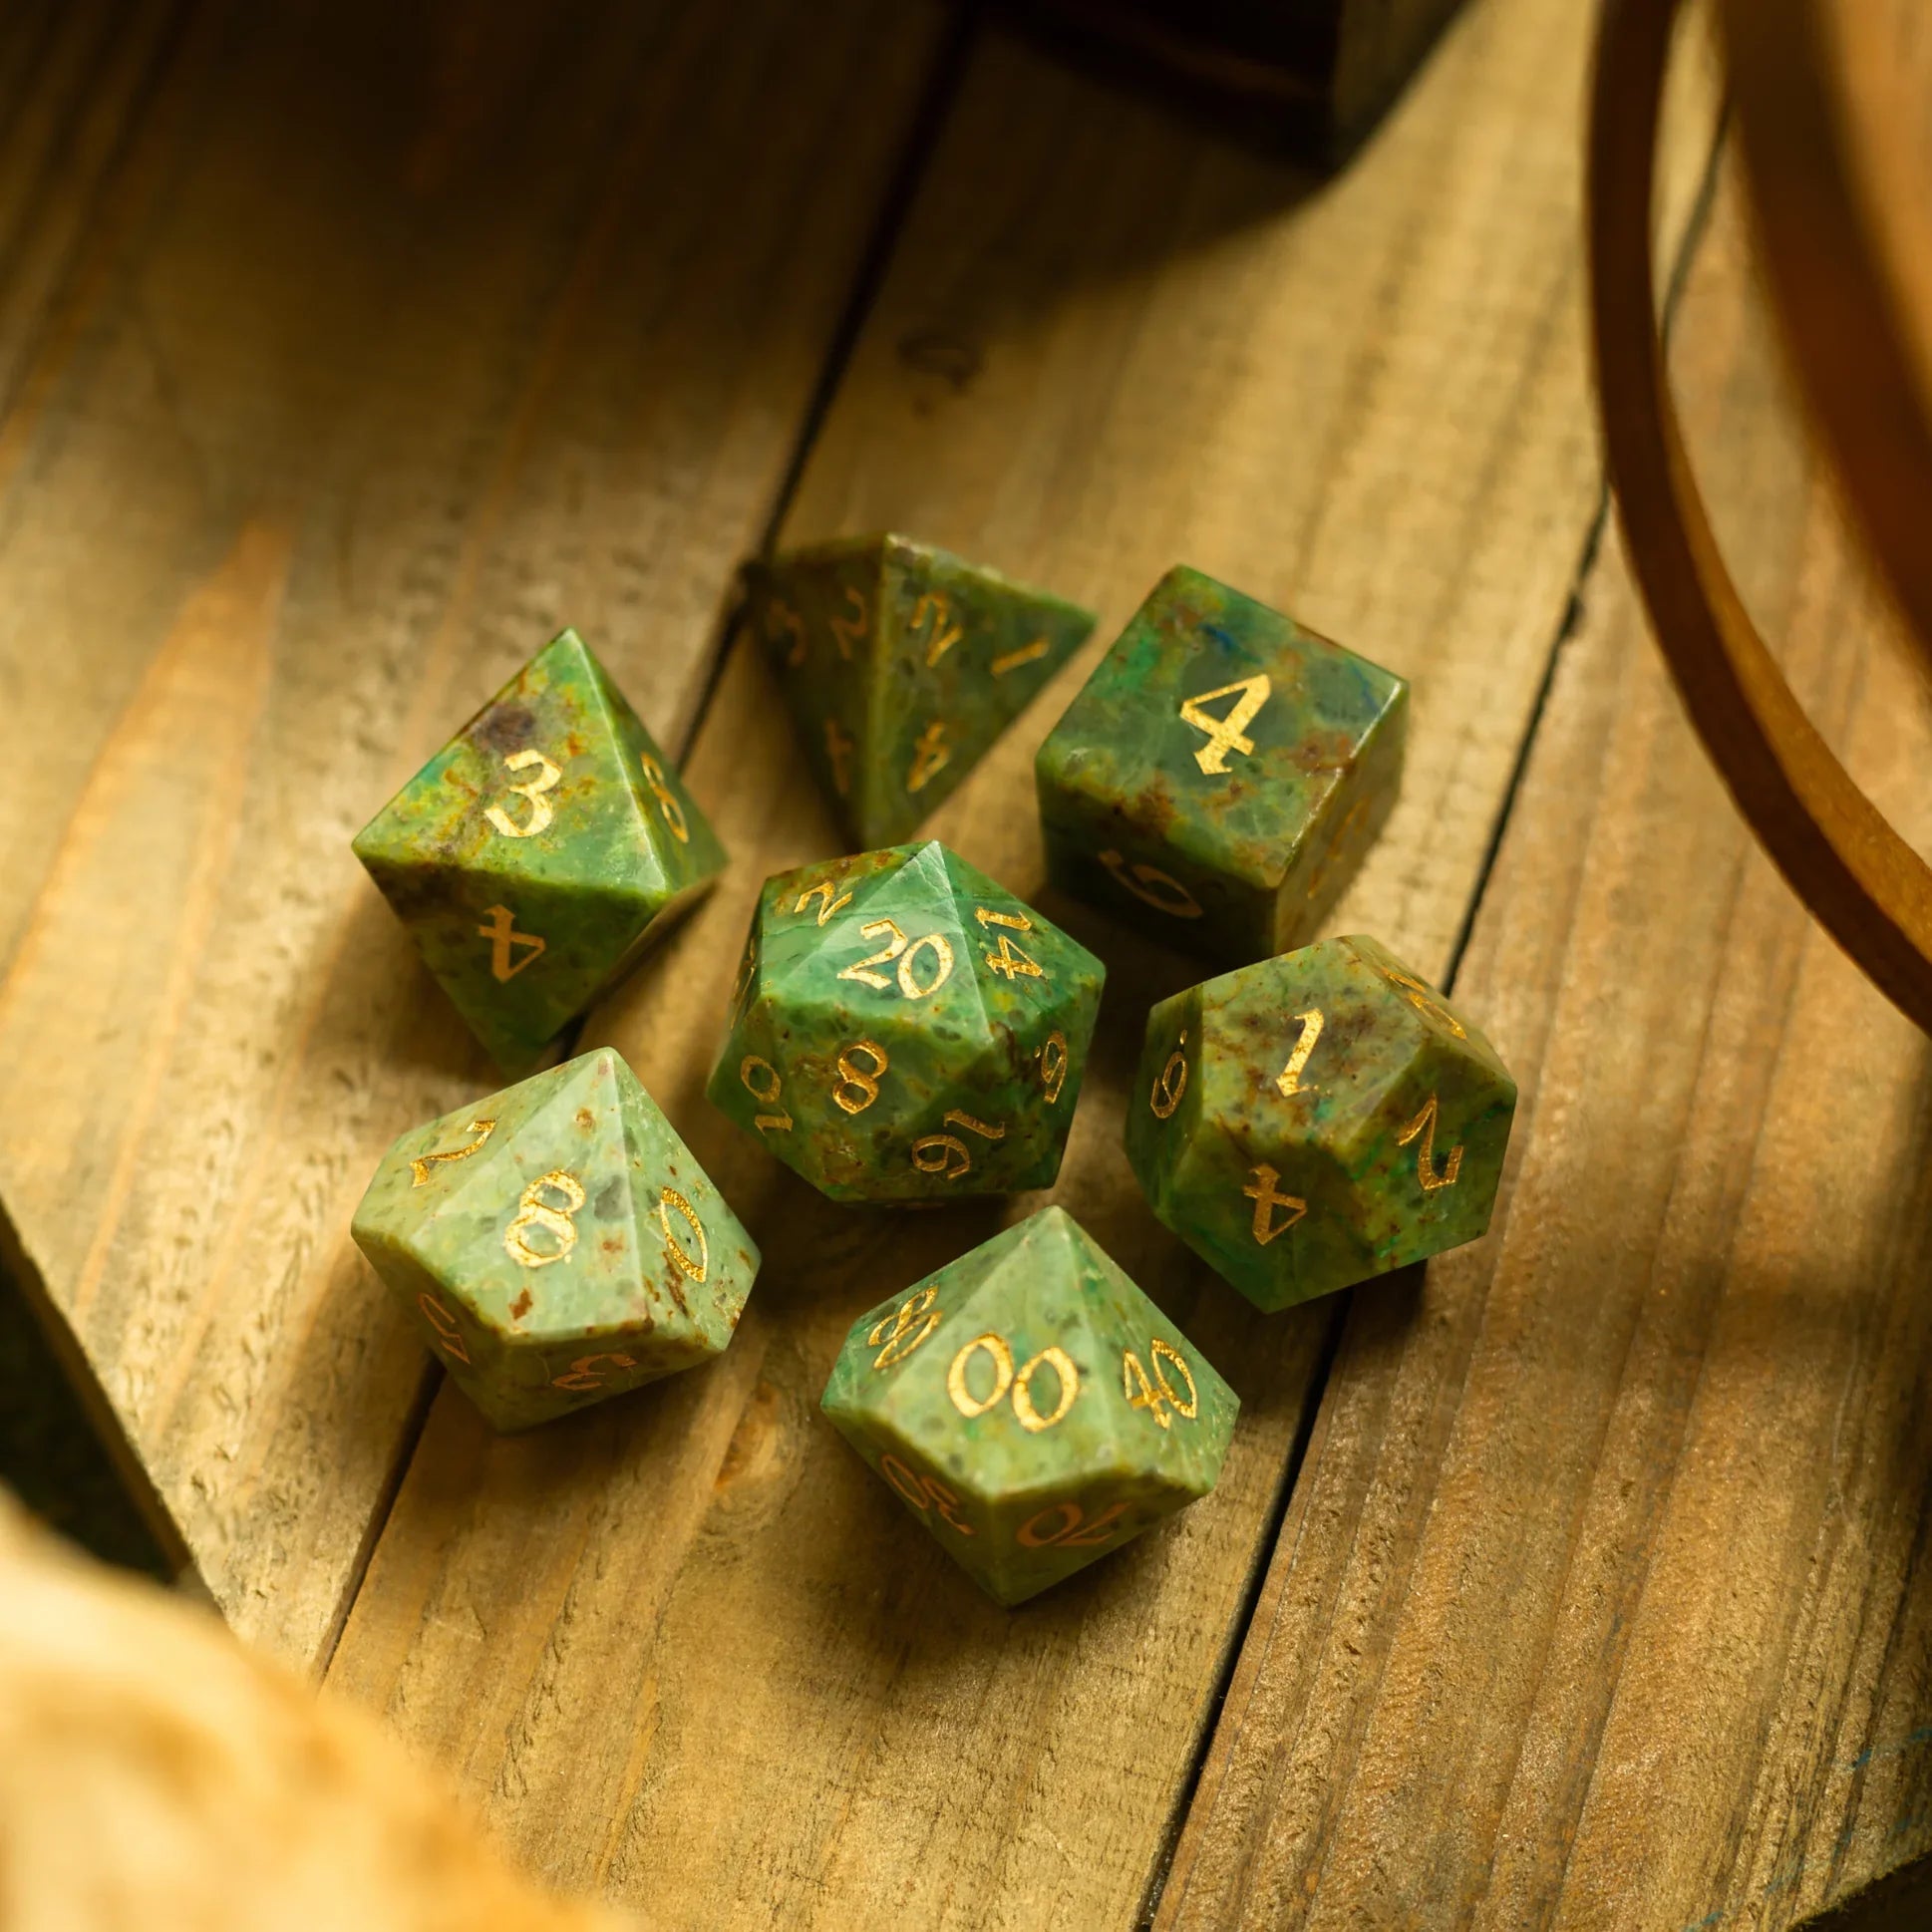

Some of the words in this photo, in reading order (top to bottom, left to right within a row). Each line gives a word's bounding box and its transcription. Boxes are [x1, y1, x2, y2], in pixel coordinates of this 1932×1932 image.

[911, 593, 963, 668] 2
[908, 721, 949, 793] 4
[1180, 674, 1271, 775] 4
[484, 750, 562, 837] 3
[641, 751, 689, 843] 8
[479, 904, 545, 983] 4
[794, 881, 852, 927] 2
[974, 906, 1044, 981] 14
[837, 917, 954, 1000] 20
[832, 1039, 888, 1116] 8
[1276, 1007, 1324, 1098] 1
[741, 1055, 794, 1136] 10
[912, 1109, 1006, 1180] 16
[1398, 1092, 1463, 1190] 2
[503, 1169, 586, 1268] 8
[660, 1185, 709, 1284] 0
[1243, 1162, 1307, 1246] 4
[868, 1286, 942, 1371] 80
[947, 1332, 1080, 1433] 00
[1124, 1338, 1198, 1430] 40
[1016, 1501, 1132, 1549] 70
